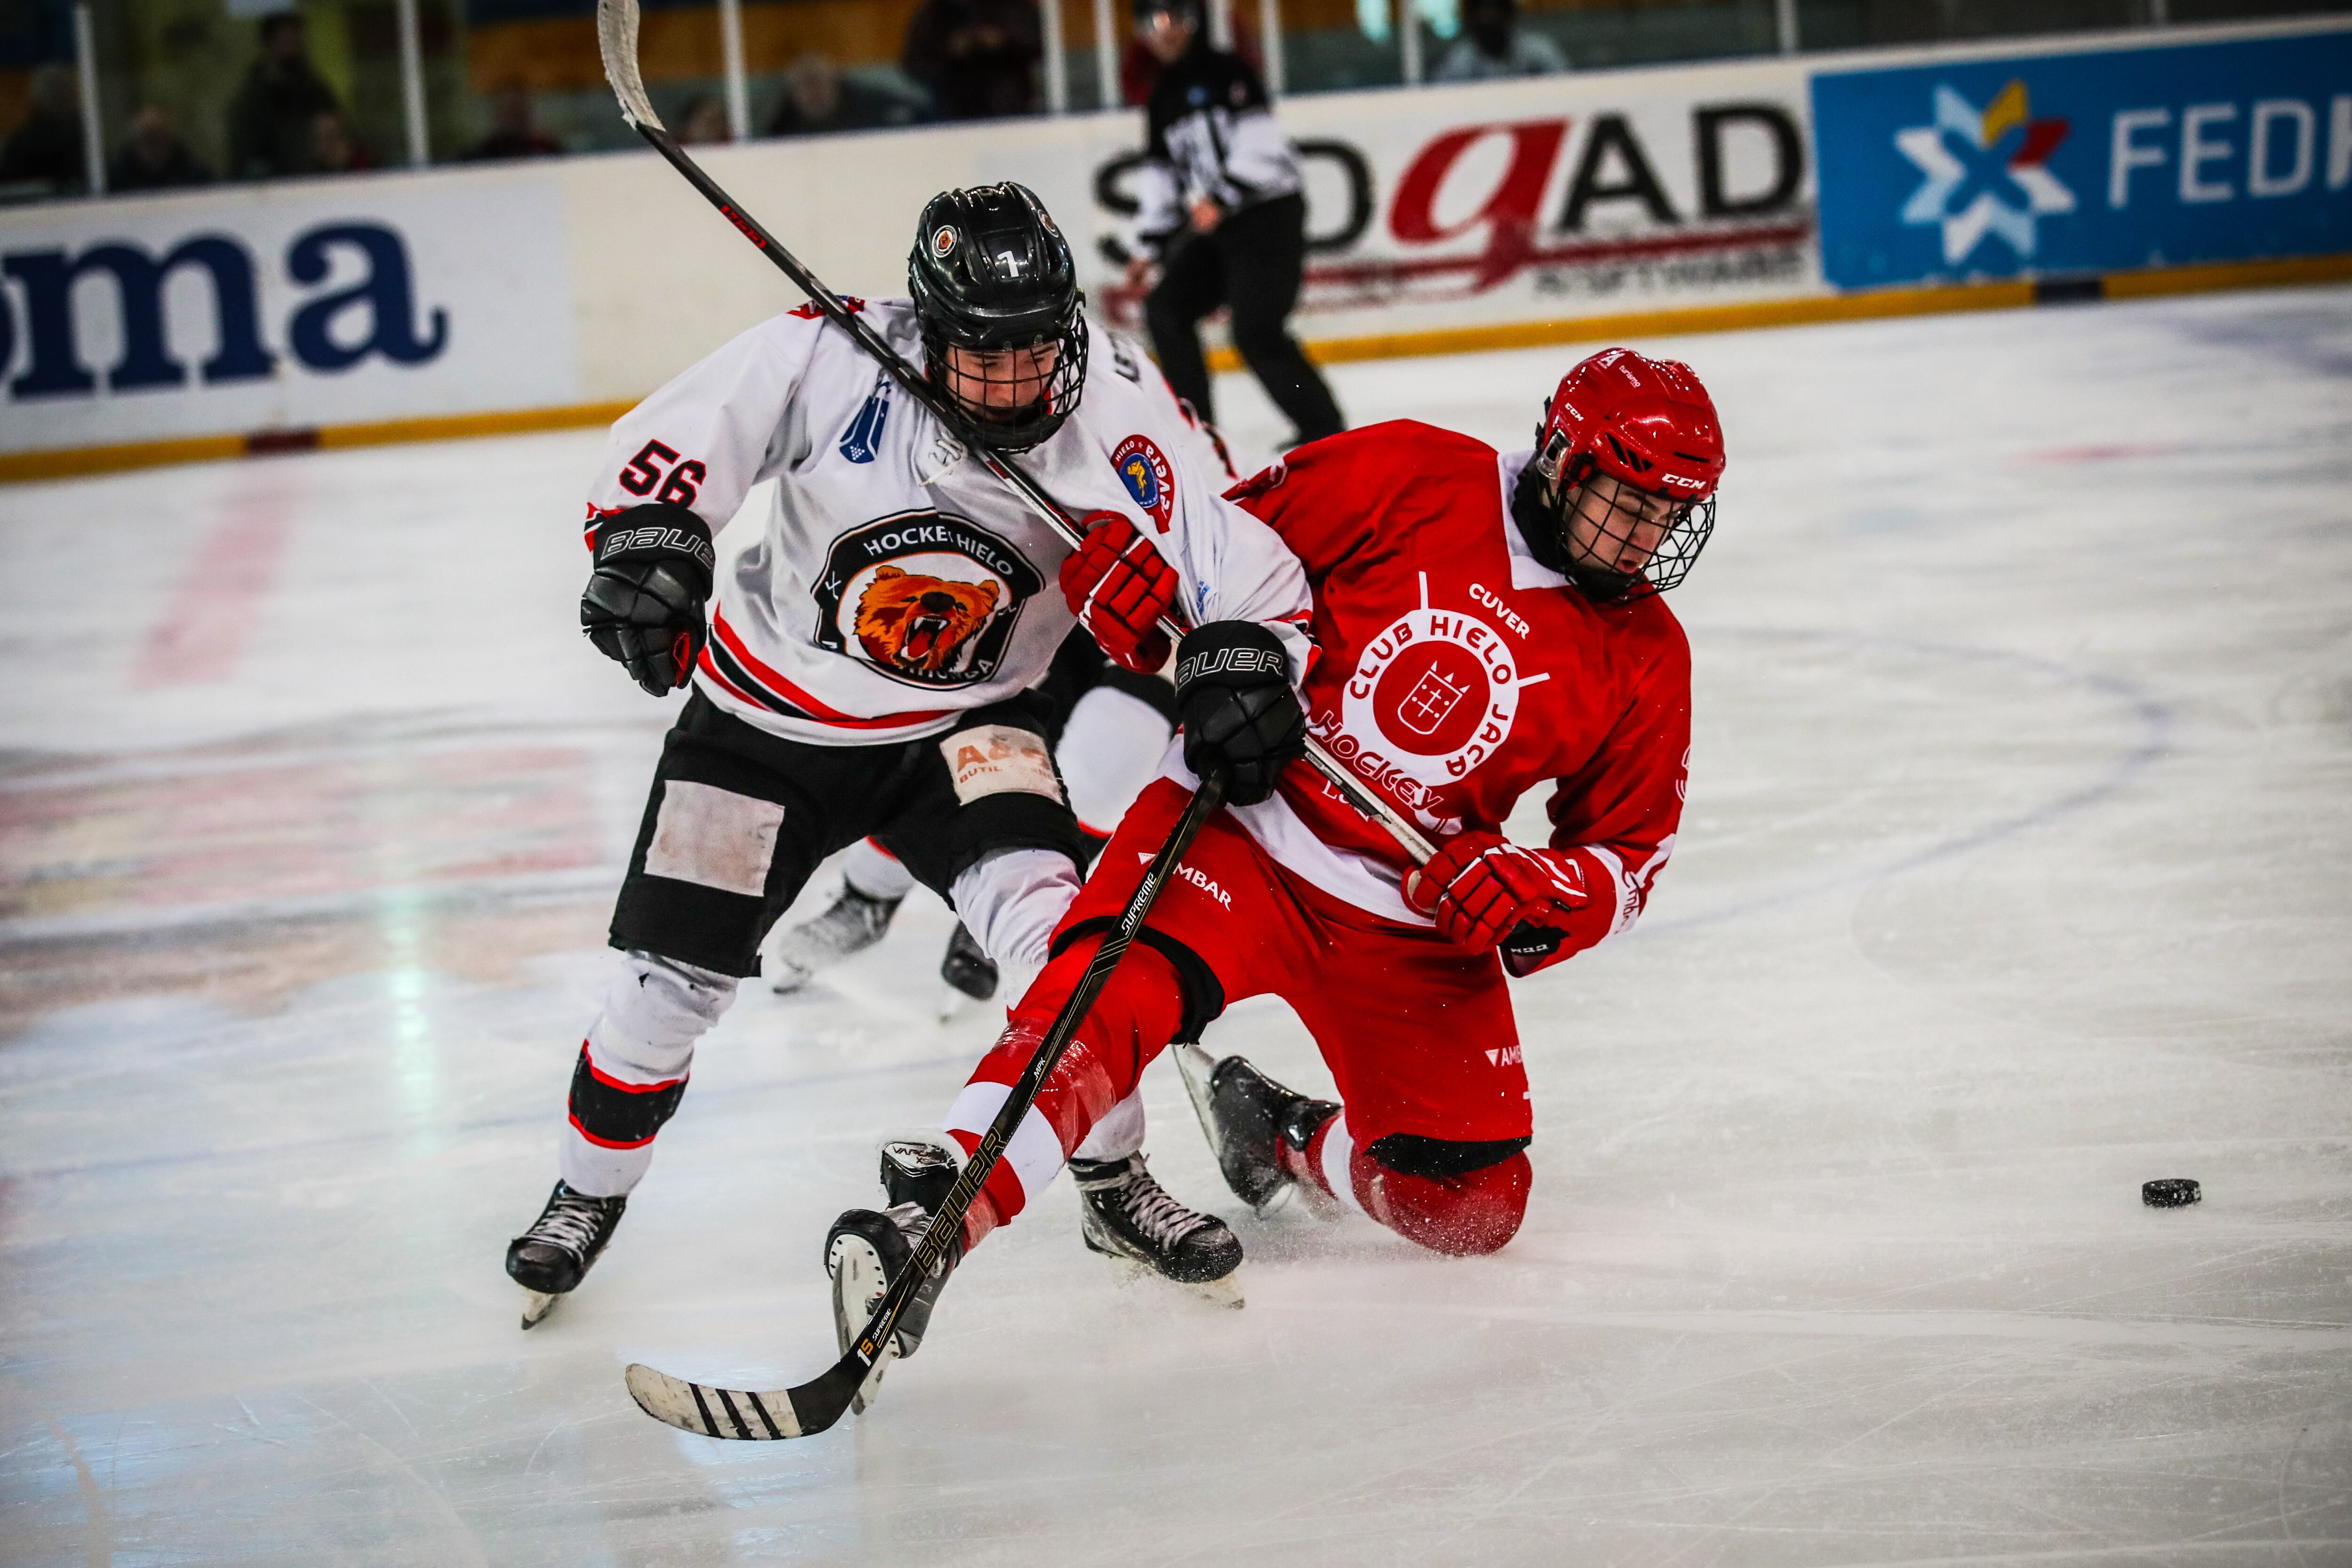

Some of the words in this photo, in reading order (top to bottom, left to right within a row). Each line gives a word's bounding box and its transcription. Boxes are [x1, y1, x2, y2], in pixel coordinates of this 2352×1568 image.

[997, 250, 1019, 278] 1
[0, 216, 450, 399] ma
[1619, 365, 1641, 387] turismo
[1565, 402, 1584, 422] CCM
[619, 439, 706, 508] 56
[1115, 440, 1135, 462] HIELO
[1661, 472, 1707, 490] CCM
[863, 525, 954, 556] HOCKE
[956, 533, 1013, 575] HIELO
[1469, 583, 1531, 640] CUVER
[1175, 647, 1284, 692] AUER
[1349, 622, 1414, 700] CLUB
[1430, 614, 1512, 685] HIELO
[1311, 709, 1444, 811] HOCKEY
[1445, 703, 1509, 777] JACA
[1120, 872, 1157, 936] SUPREME
[1173, 861, 1231, 912] MBAR
[1033, 1057, 1046, 1080] MPK
[913, 1126, 1009, 1277] BAUER
[872, 1308, 892, 1342] SUPREME
